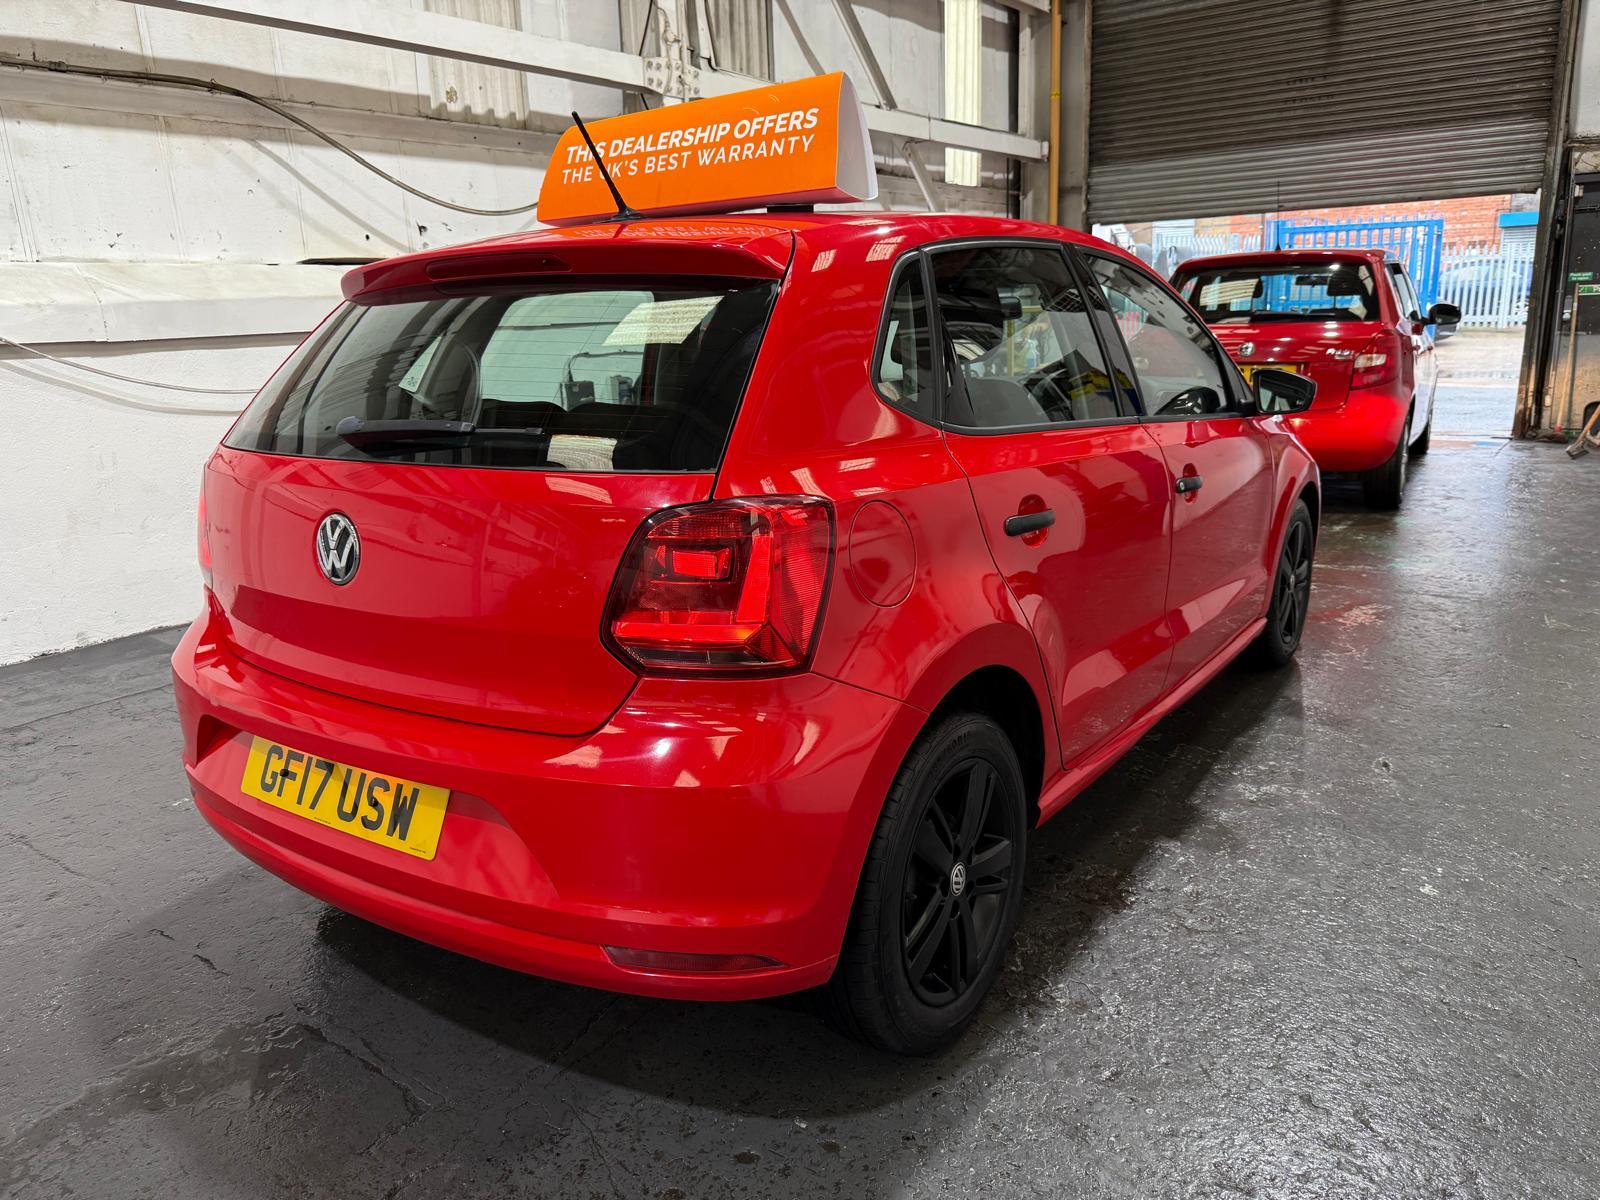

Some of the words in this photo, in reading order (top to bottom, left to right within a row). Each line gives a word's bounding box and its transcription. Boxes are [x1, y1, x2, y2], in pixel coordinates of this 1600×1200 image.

[562, 166, 593, 184] THE
[645, 151, 692, 173] BEST
[697, 134, 815, 166] WARRANTY
[567, 141, 607, 164] THIS
[609, 122, 731, 158] DEALERSHIP
[733, 107, 820, 139] OFFERS
[260, 744, 335, 811] GF17
[336, 768, 420, 841] USW
